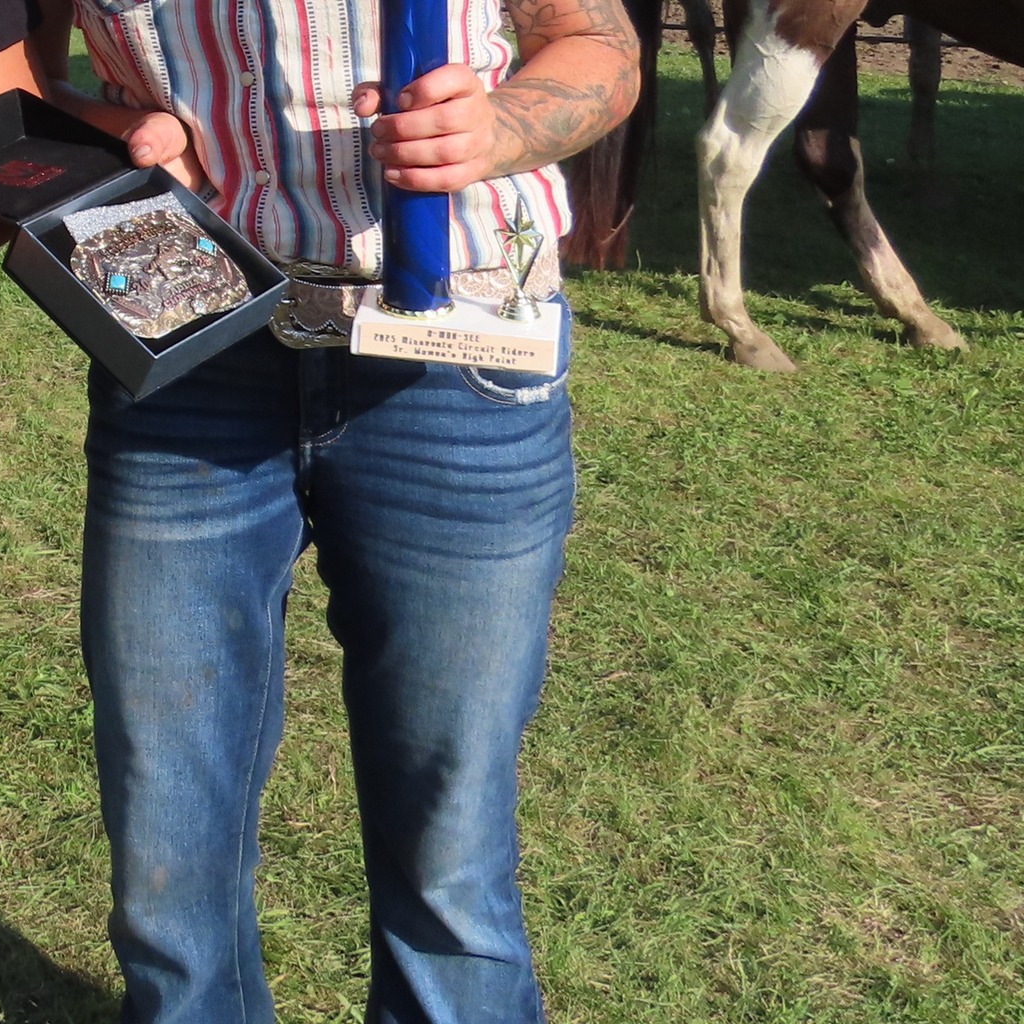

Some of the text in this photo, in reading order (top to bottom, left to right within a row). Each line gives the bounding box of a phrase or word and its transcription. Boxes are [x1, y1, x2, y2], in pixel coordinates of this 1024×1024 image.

[373, 333, 535, 357] 2025 Minnesota Circuit Riders
[414, 347, 456, 358] Women's
[462, 351, 484, 363] High
[489, 355, 516, 366] Point
